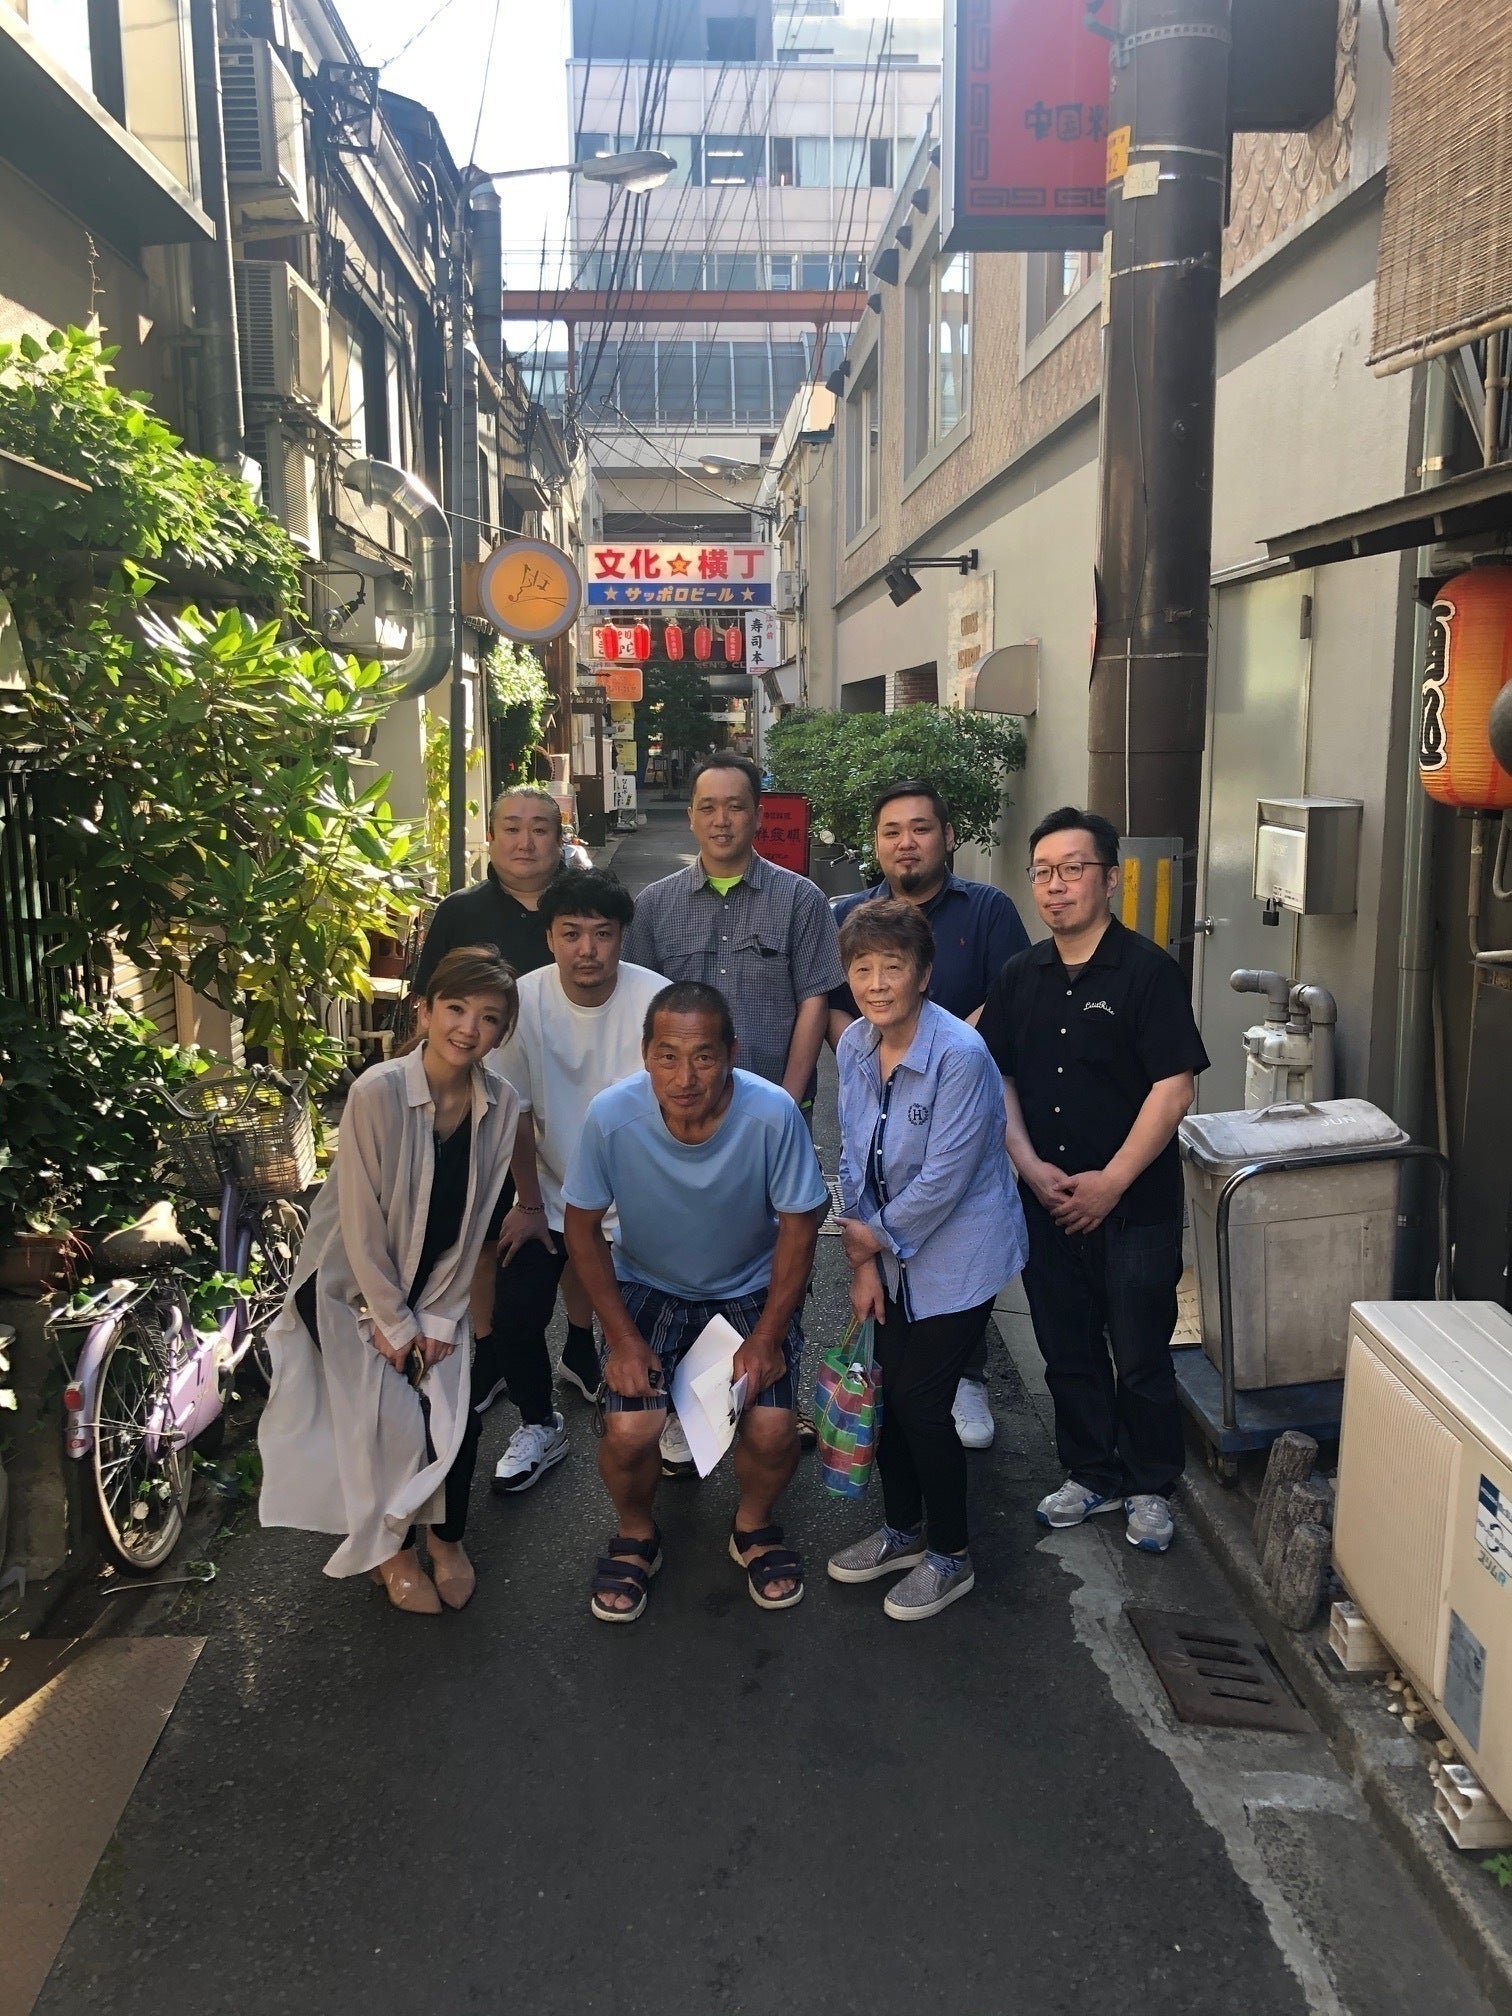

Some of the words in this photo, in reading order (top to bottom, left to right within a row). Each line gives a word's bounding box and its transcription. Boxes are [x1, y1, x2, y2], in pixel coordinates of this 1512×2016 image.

[595, 548, 661, 580] 文化
[697, 548, 765, 580] 横丁
[625, 586, 735, 602] サッポロビール
[765, 614, 776, 641] 江戸前
[750, 618, 765, 665] 寿司本
[912, 1109, 922, 1121] H
[1320, 1116, 1357, 1127] JUN
